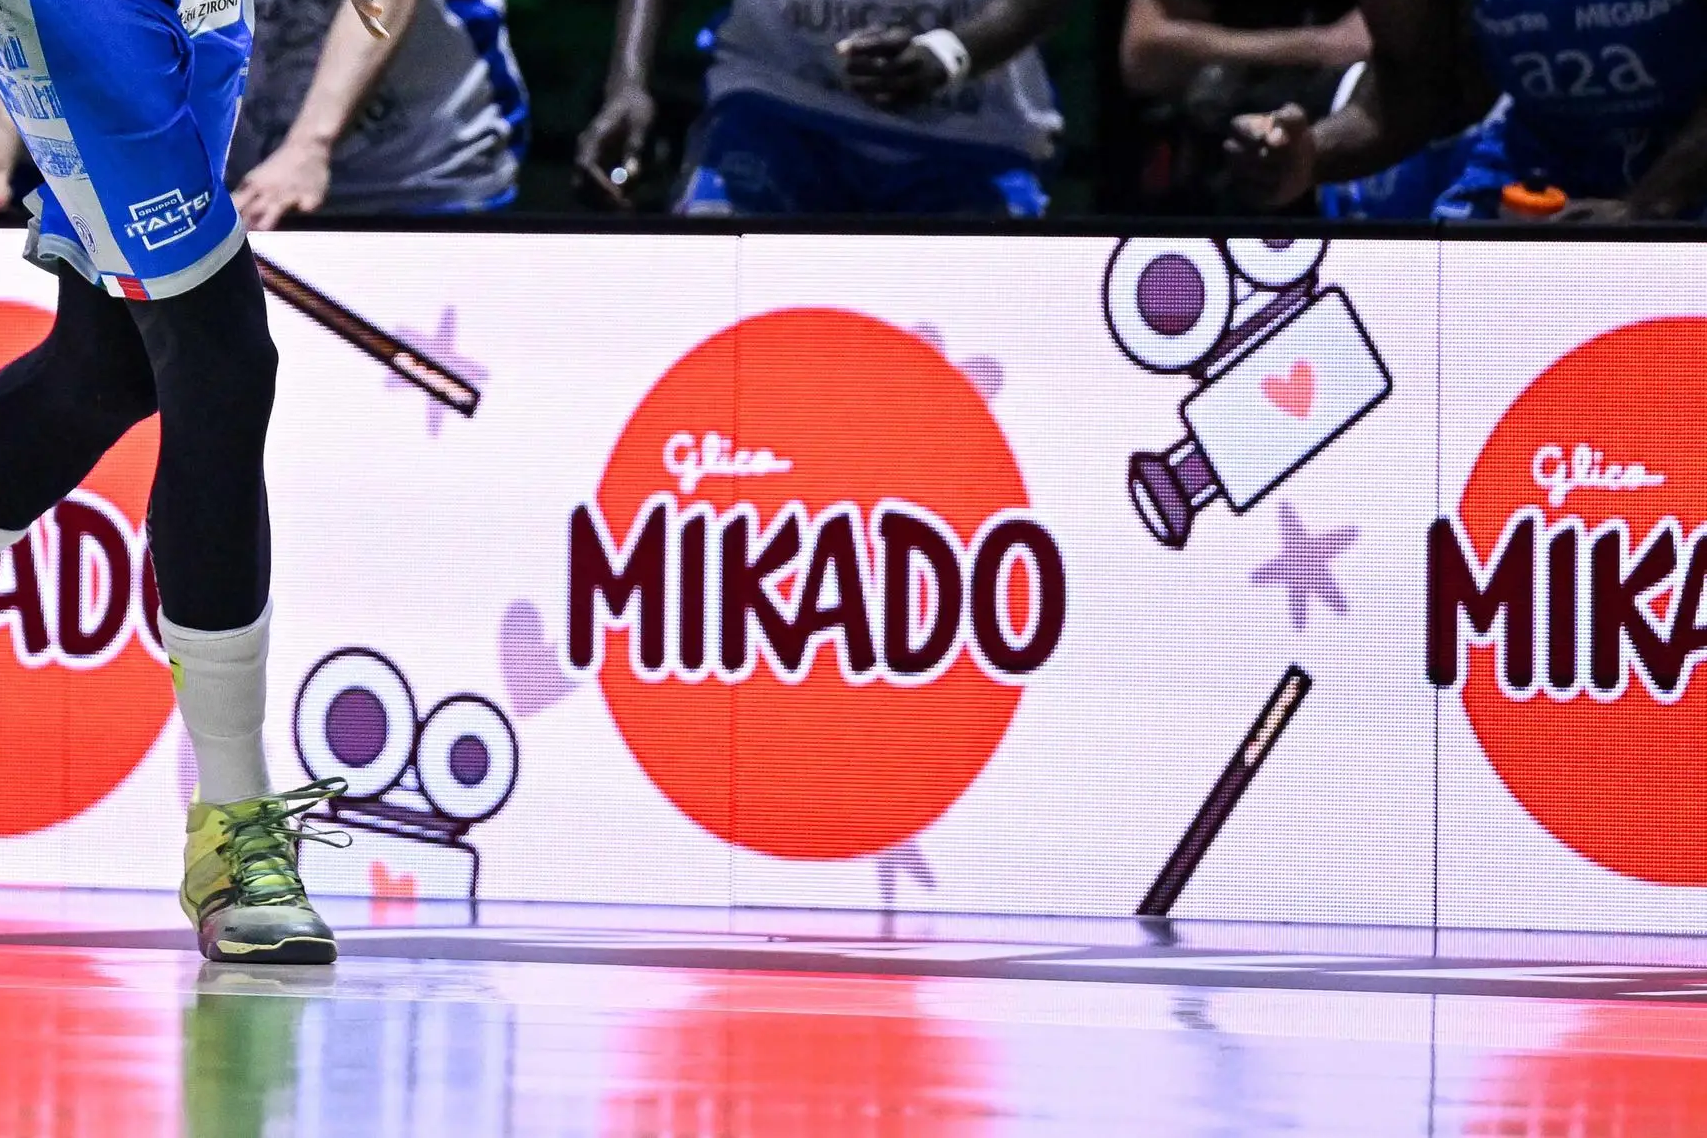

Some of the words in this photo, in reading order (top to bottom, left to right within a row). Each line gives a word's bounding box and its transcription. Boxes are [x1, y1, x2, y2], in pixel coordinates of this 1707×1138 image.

[138, 198, 178, 216] GRUPPO
[662, 431, 794, 494] Glico
[1532, 442, 1669, 509] Glico
[568, 501, 1068, 674] MIKADO
[1426, 514, 1707, 693] MIK
